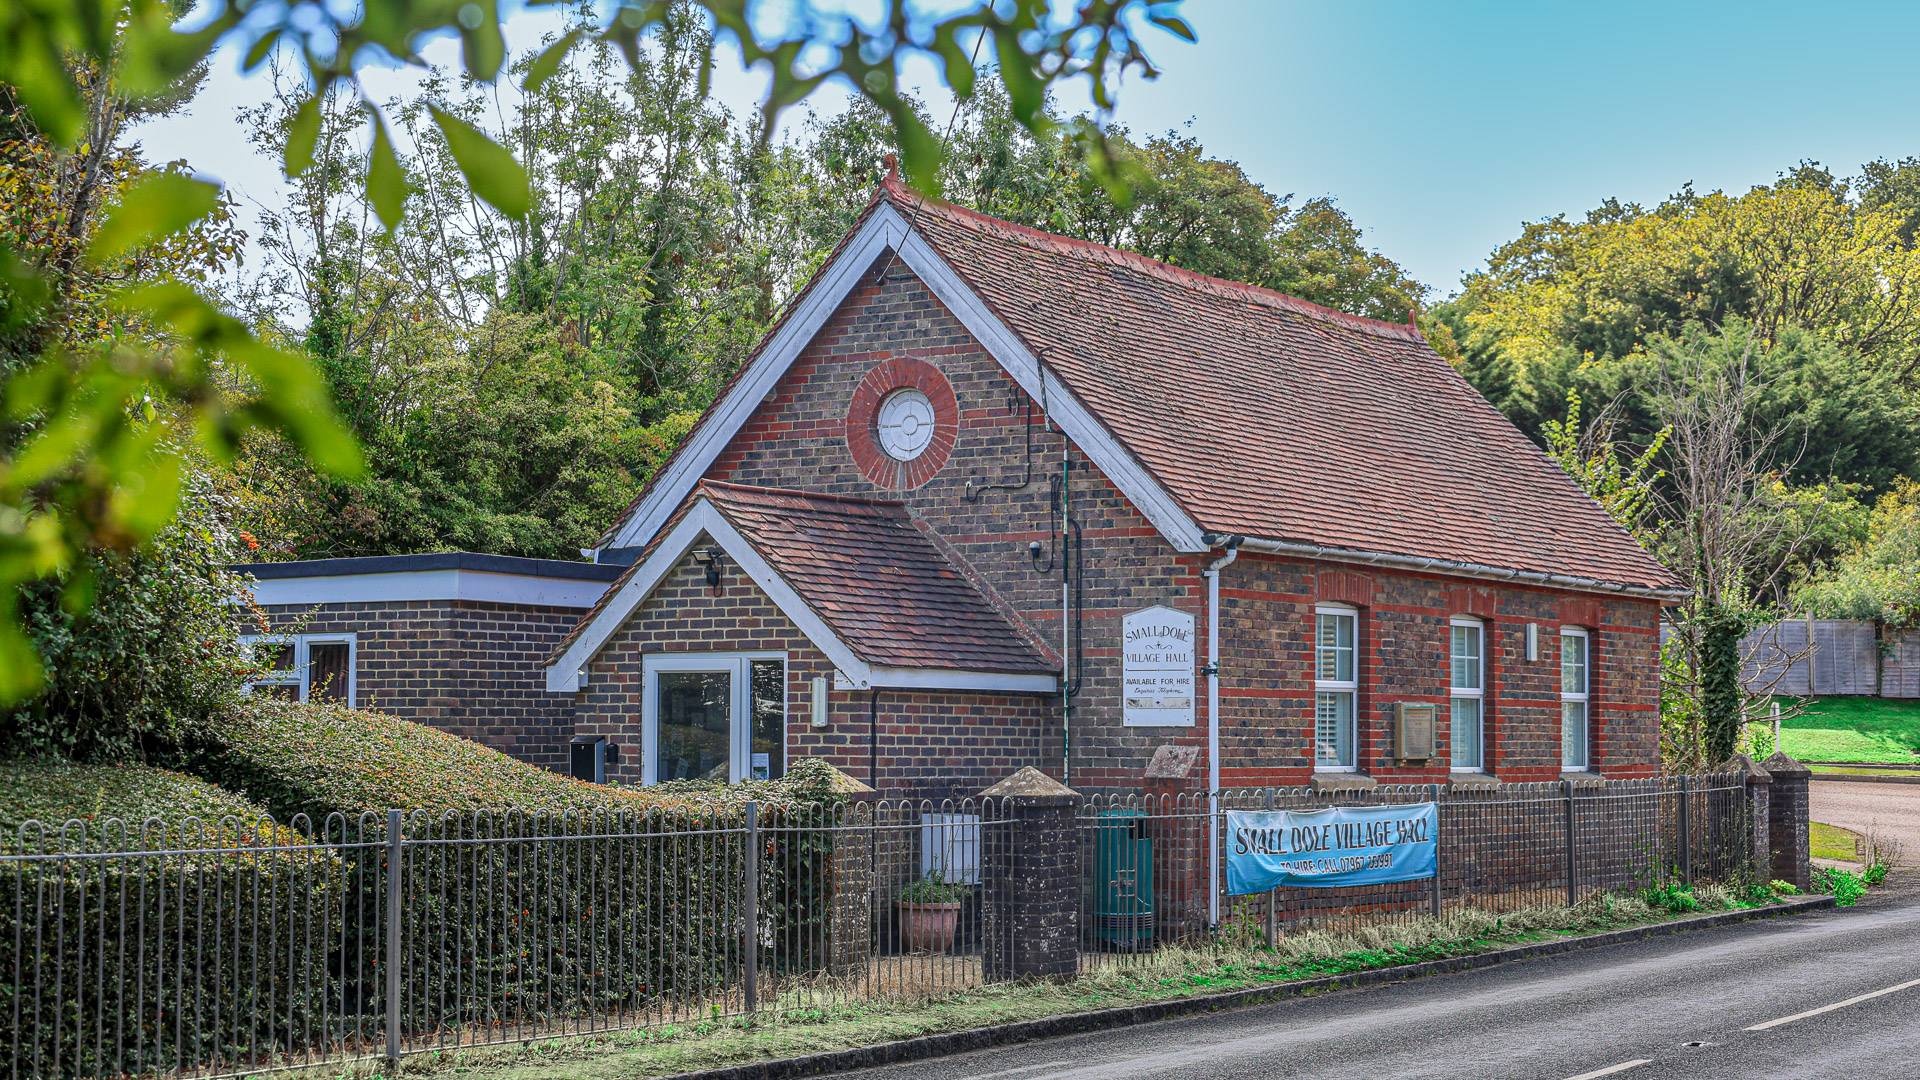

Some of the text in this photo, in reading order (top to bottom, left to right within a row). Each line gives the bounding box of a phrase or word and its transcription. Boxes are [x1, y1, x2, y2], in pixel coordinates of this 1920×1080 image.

[1125, 625, 1188, 643] SMALL DOLE
[1126, 653, 1188, 663] VILLAGE HALL
[1291, 824, 1331, 854] DOLE
[1334, 821, 1394, 850] VILLAGE
[1396, 817, 1429, 844] HALL
[1318, 858, 1340, 874] CALL
